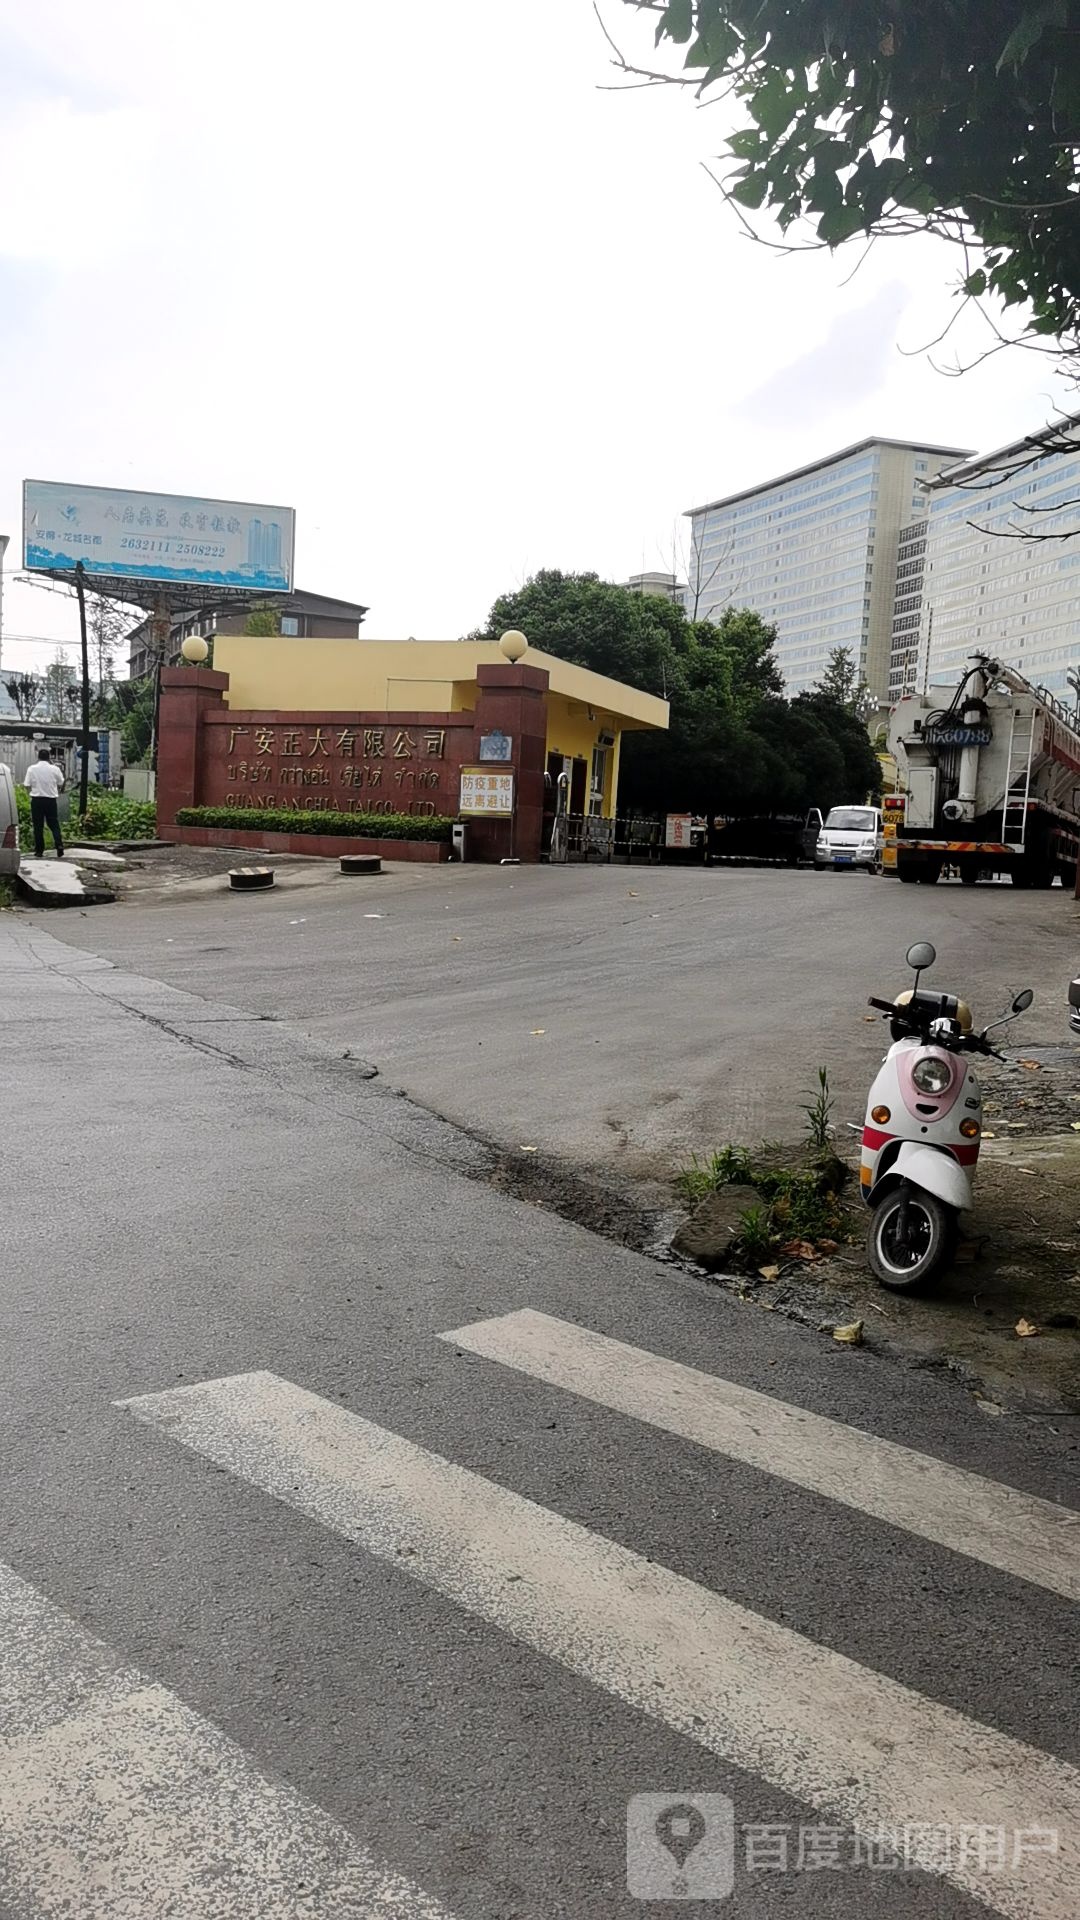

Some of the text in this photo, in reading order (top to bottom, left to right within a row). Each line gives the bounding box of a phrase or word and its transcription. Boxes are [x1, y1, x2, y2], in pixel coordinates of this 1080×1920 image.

[120, 538, 170, 553] 2632111
[176, 543, 226, 558] 2508222
[228, 727, 445, 759] 广安正大有限公司
[462, 776, 511, 791] 防疫重地
[226, 793, 276, 809] GUANG
[305, 797, 341, 812] CHIA
[462, 794, 511, 808] 远离避让
